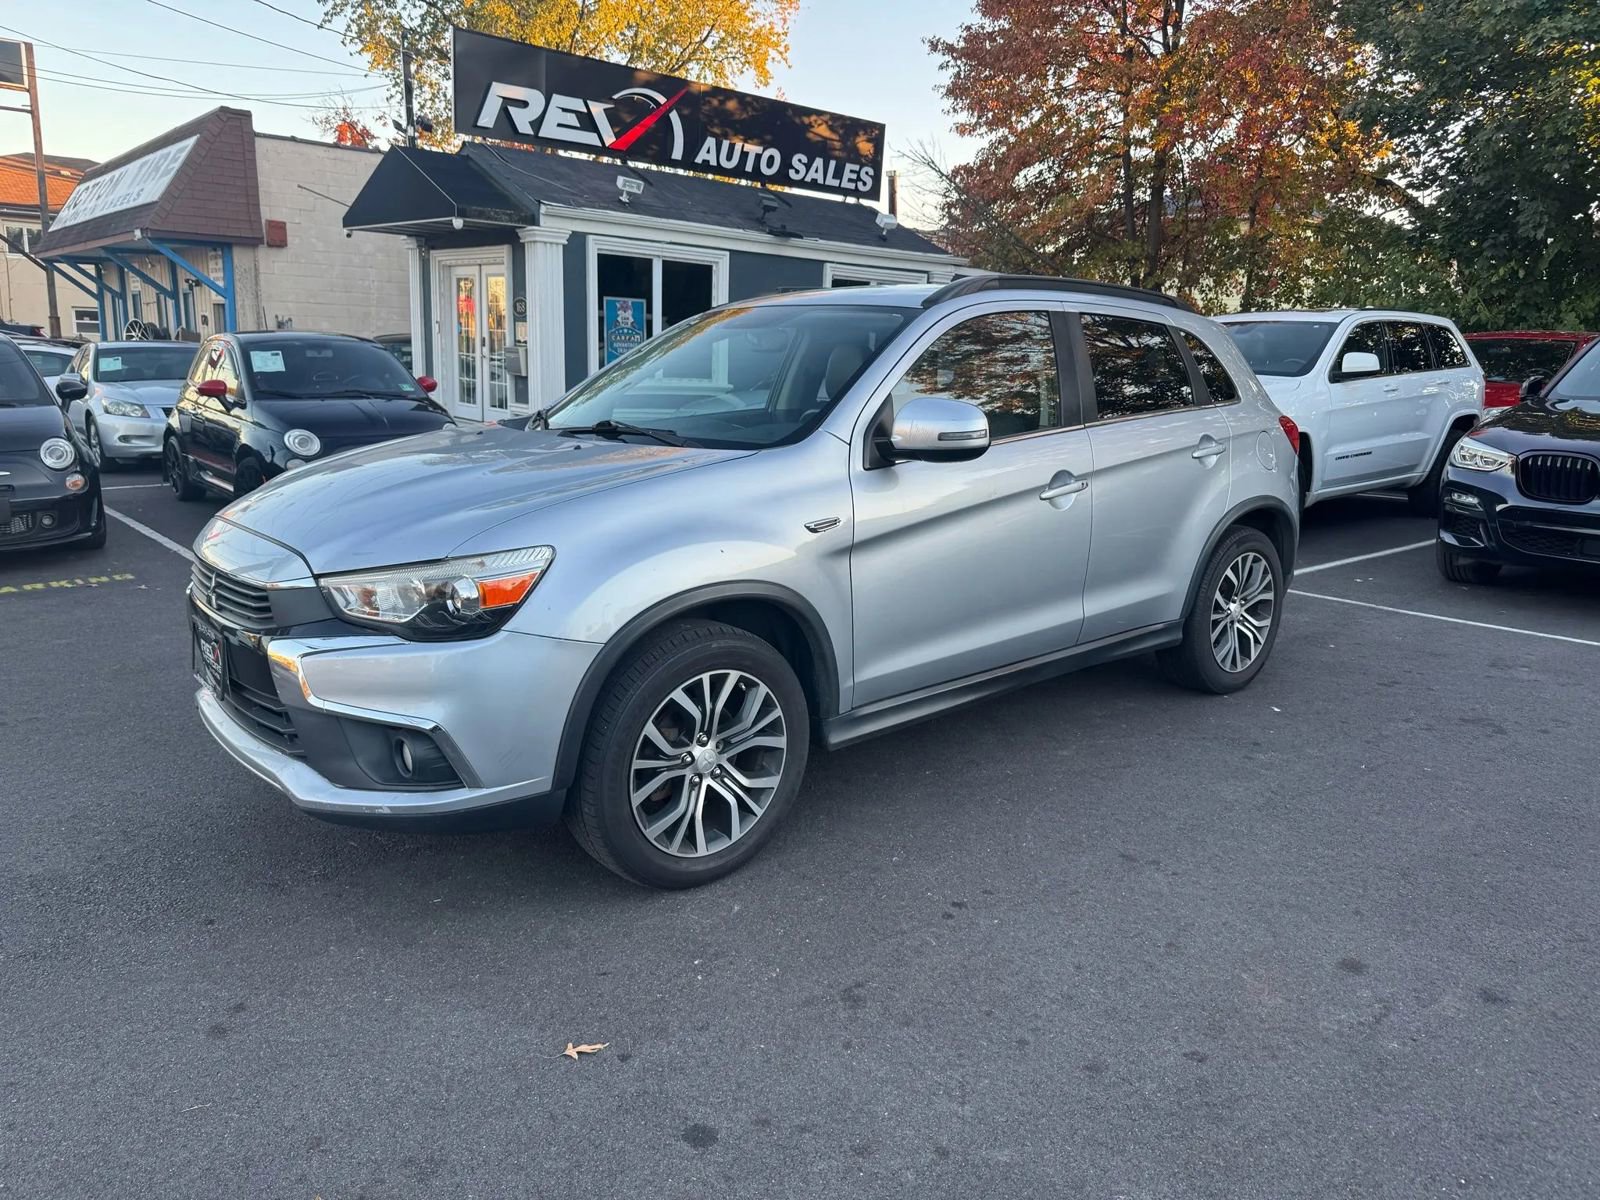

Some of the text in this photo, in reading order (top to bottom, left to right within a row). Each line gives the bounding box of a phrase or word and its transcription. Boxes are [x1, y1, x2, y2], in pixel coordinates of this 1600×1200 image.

[476, 81, 688, 151] REV
[62, 167, 129, 212] ACTION
[694, 136, 875, 192] AUTO SALES
